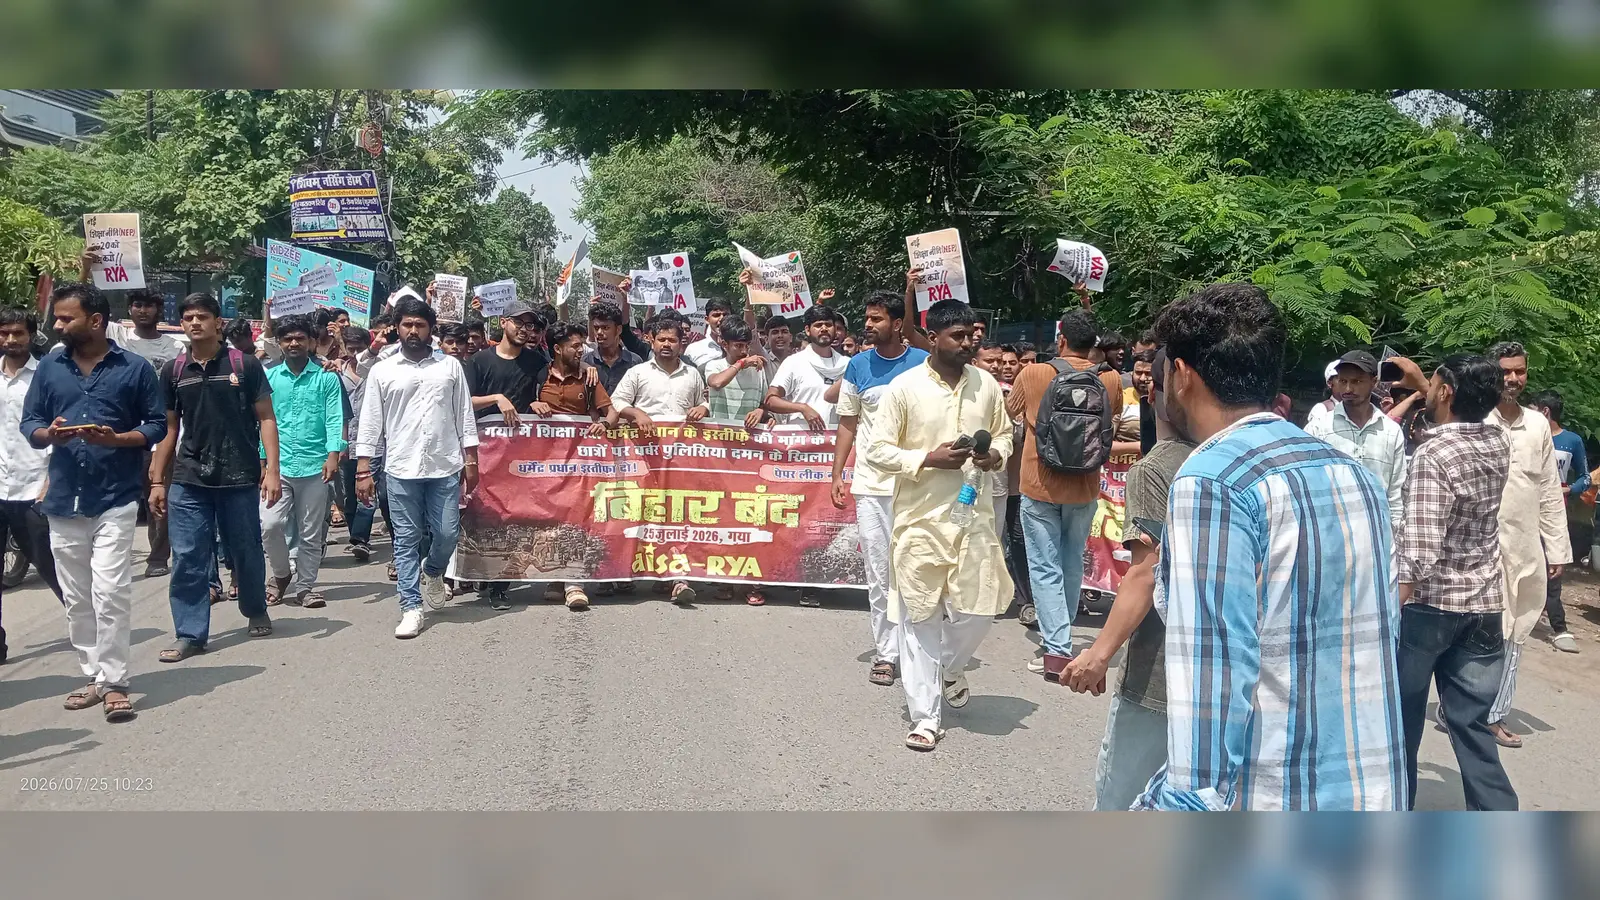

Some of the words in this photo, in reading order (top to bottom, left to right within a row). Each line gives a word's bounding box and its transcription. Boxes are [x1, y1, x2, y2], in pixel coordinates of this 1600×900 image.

[322, 174, 345, 186] नर्सिंग
[346, 173, 362, 186] होम
[89, 228, 105, 239] शिक्षा
[270, 244, 301, 262] KIDZEE
[913, 249, 928, 259] शिक्षा
[104, 264, 129, 282] RYA
[1090, 256, 1104, 280] RYA
[928, 283, 952, 301] RYA
[484, 426, 512, 438] गया
[519, 424, 532, 437] में
[536, 424, 576, 438] शिक्षा
[684, 425, 698, 438] के
[703, 426, 750, 445] इस्तीफे
[754, 430, 773, 445] की
[778, 431, 806, 446] मांग
[810, 432, 825, 446] के
[577, 444, 607, 457] छात्रों
[611, 445, 630, 456] पर
[662, 443, 727, 459] पुलिसिया
[731, 448, 763, 460] दमन
[768, 449, 783, 461] के
[548, 463, 578, 473] प्रधान
[580, 463, 616, 475] इस्तीफा
[774, 468, 795, 479] पेपर
[799, 469, 824, 479] लीक
[590, 480, 726, 524] बिहार
[731, 484, 805, 528] बंद
[692, 530, 723, 544] 2026,
[728, 531, 751, 543] गया
